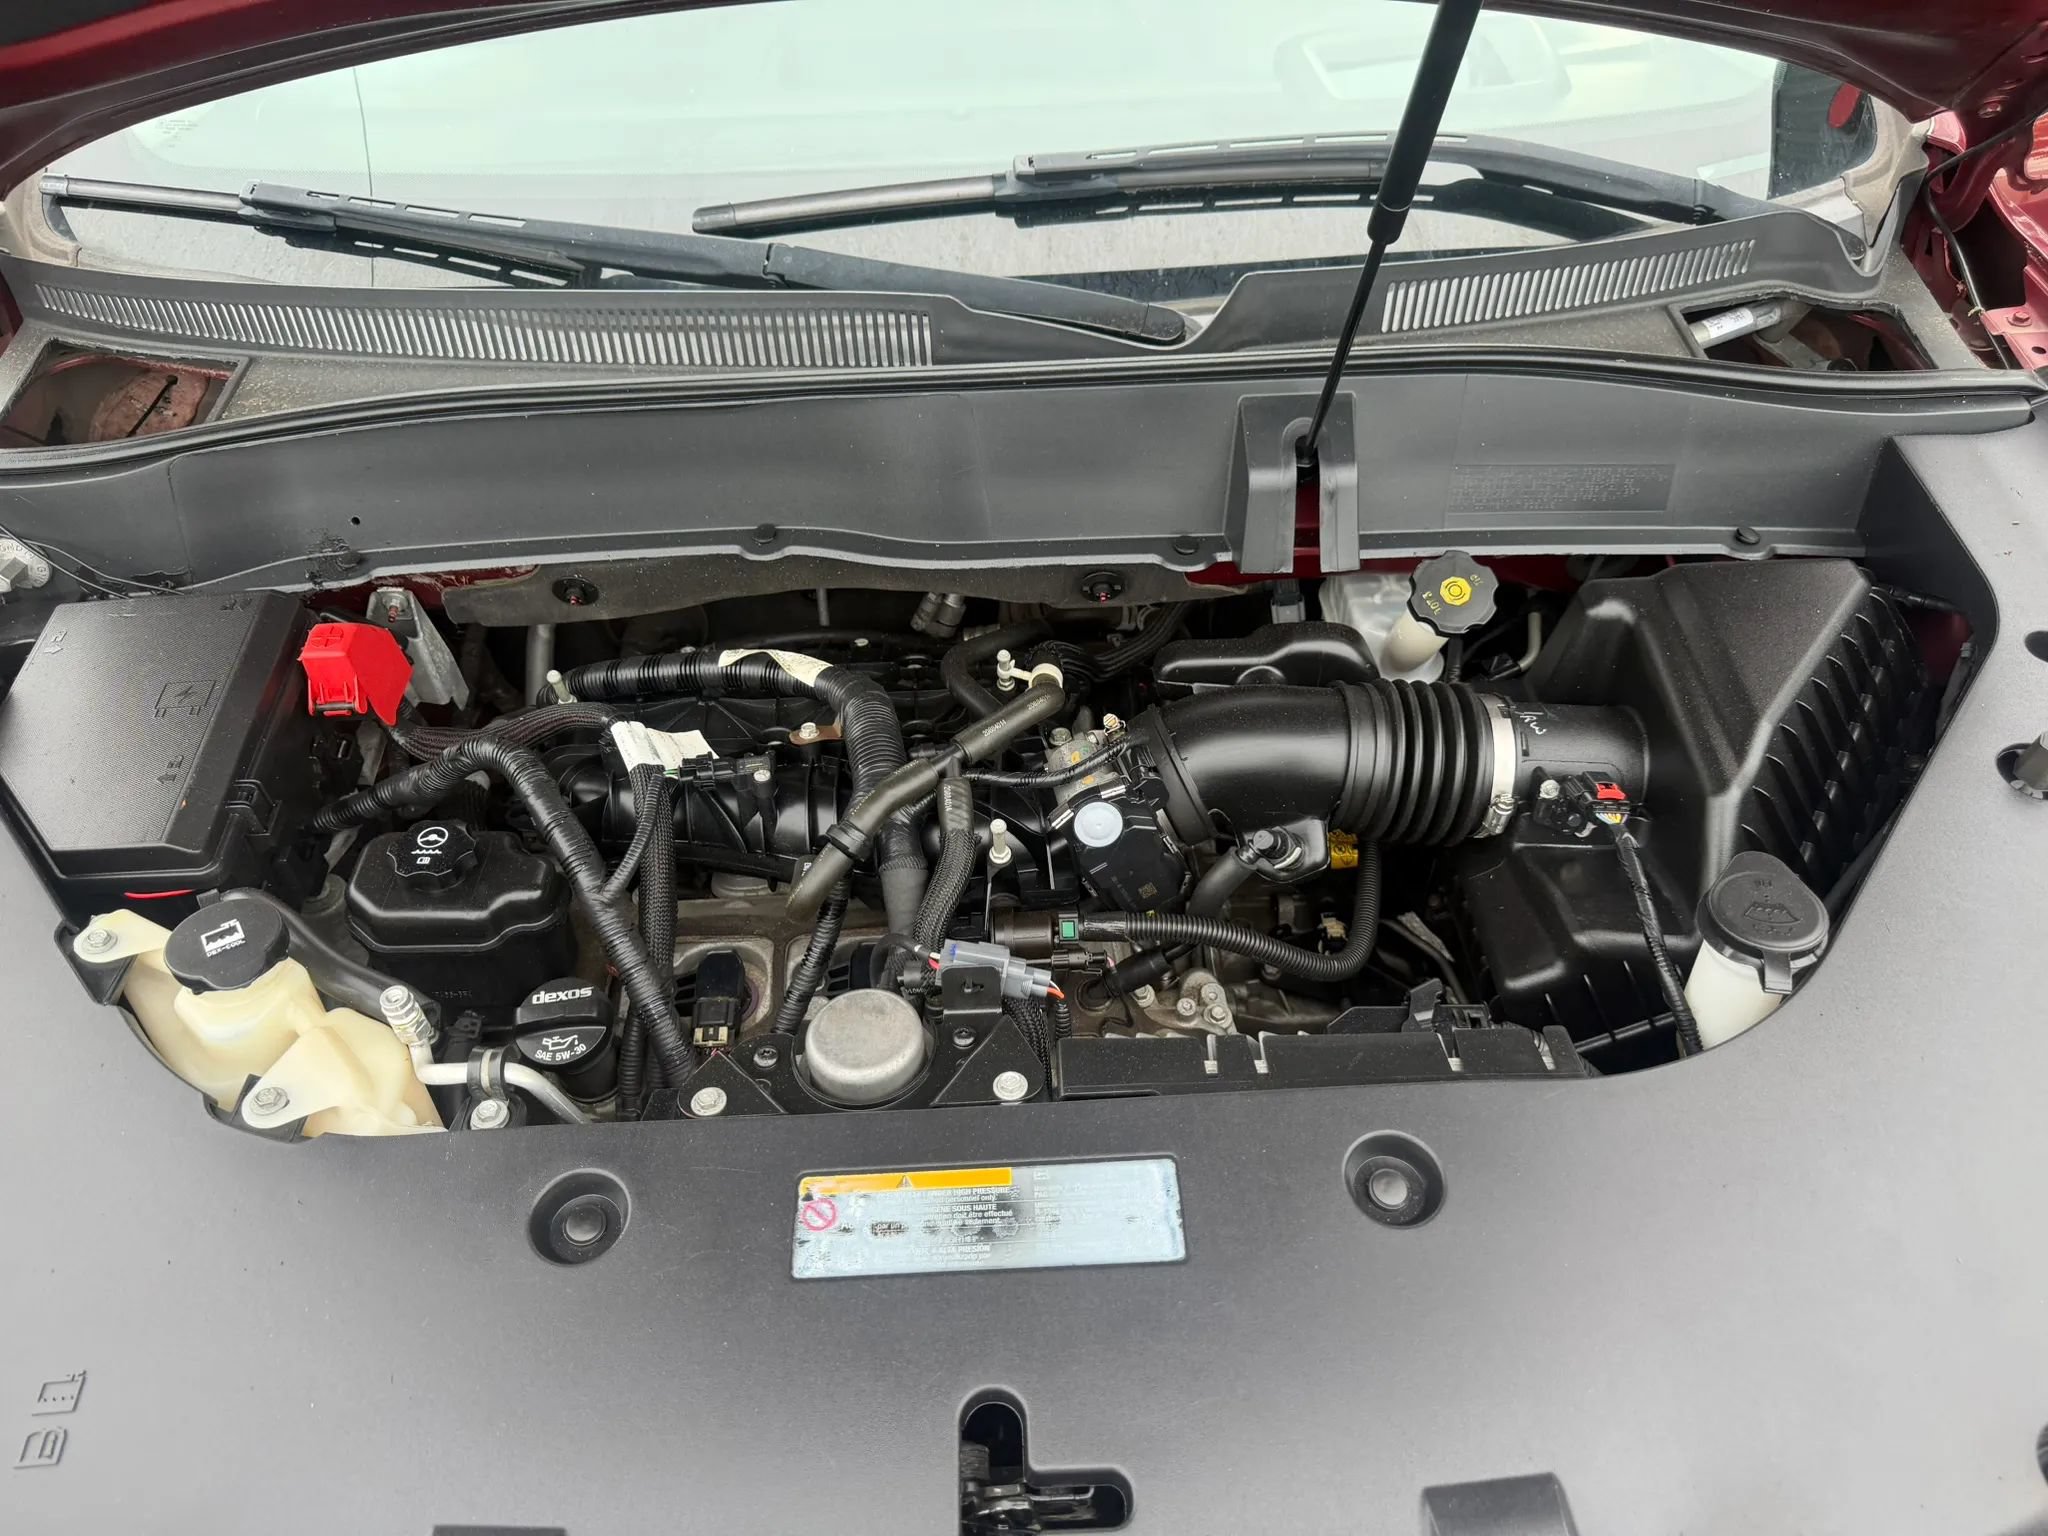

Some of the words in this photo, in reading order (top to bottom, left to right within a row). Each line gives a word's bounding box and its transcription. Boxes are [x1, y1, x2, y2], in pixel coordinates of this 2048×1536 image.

[206, 939, 246, 958] DEX-COOL
[532, 986, 594, 1005] dexos
[534, 1049, 553, 1061] SAE
[555, 1043, 587, 1061] 5W-30
[973, 1186, 1010, 1194] PRESSURE
